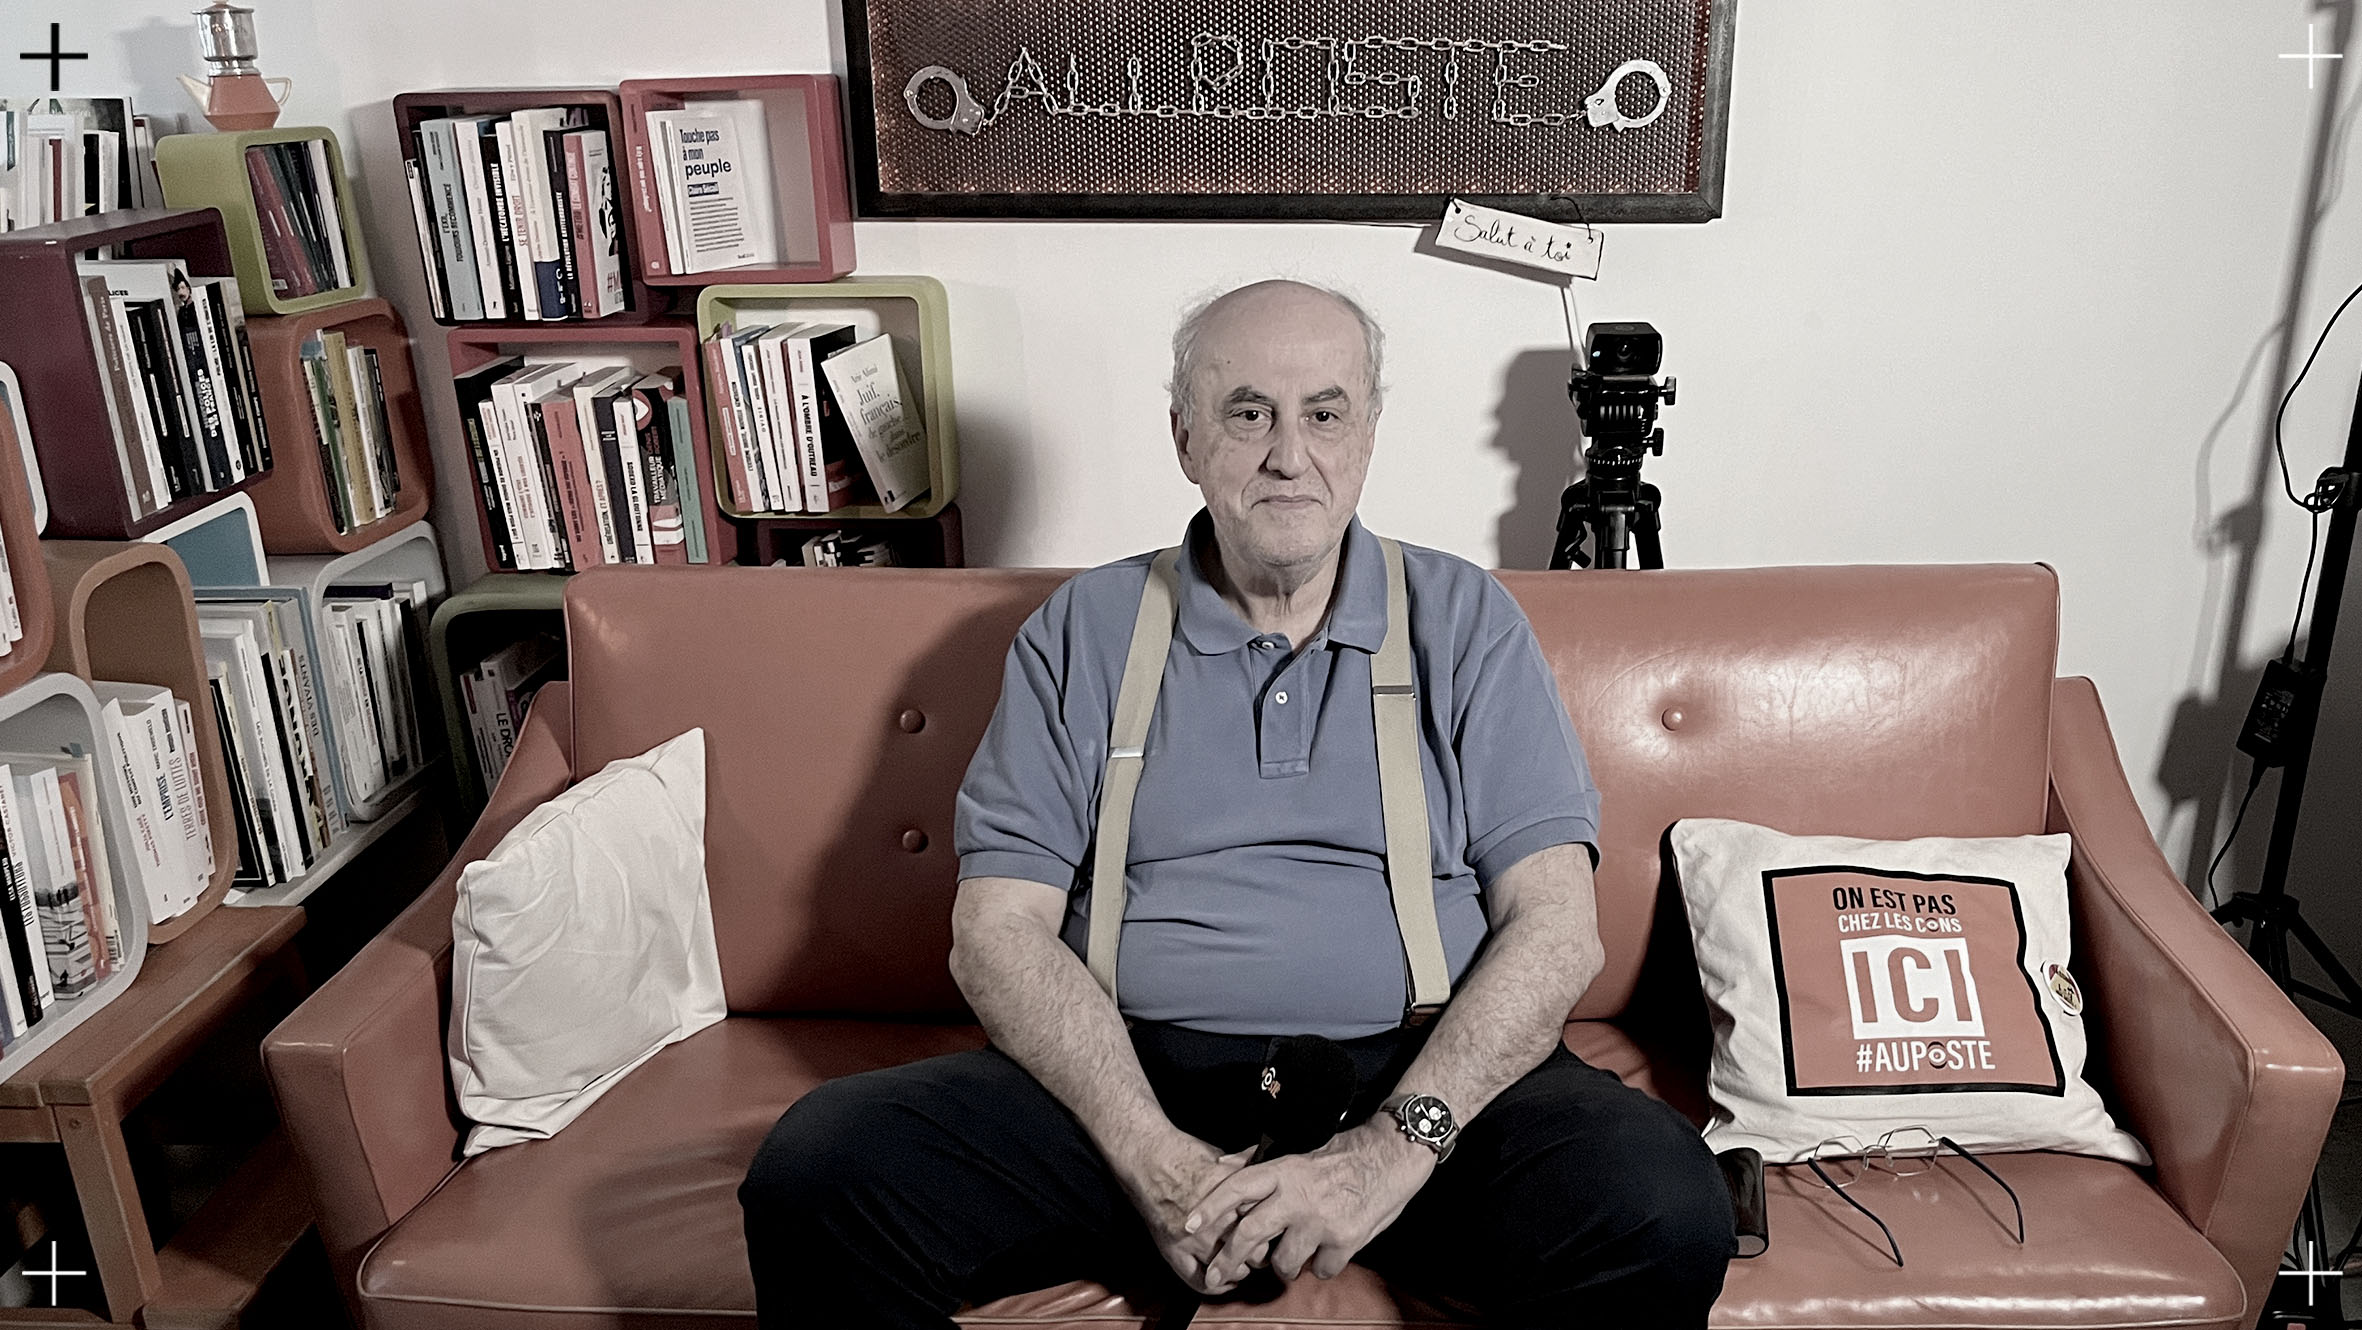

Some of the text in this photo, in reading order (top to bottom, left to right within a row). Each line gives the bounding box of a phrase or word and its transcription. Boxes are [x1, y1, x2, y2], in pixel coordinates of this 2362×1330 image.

[680, 128, 720, 145] Touche pas
[683, 145, 704, 161] à mon
[685, 159, 732, 180] peuple
[442, 182, 463, 262] TOUJOURS RECOMMENCÉ
[490, 161, 509, 242] L'HÉCATOMBE INVISIBLE
[511, 194, 527, 247] SE TENIR DROIT
[555, 191, 567, 237] ANTITERRORISTE
[561, 237, 572, 271] RÉVOLUTION
[1453, 214, 1571, 262] Salut à toi
[97, 295, 121, 372] Policiers de Paris
[194, 380, 210, 428] HISTOIRE
[195, 368, 217, 437] DES POLICES
[204, 376, 219, 425] EN FRANCE
[644, 431, 653, 455] DENIS
[649, 425, 661, 454] ROBERT
[800, 393, 818, 477] À L'OMBRE D'OUTREAU
[876, 450, 885, 462] le
[595, 483, 604, 501] APRÈS
[626, 460, 643, 532] SODEXO LA GLOUTONNE
[645, 455, 662, 503] TRAVAILLEUR
[652, 454, 669, 499] MÉDIATIQUE
[599, 501, 606, 510] ET
[298, 653, 320, 736] DES VIVANTS
[117, 730, 129, 767] POLITIQUE
[495, 711, 516, 758] LE DRO
[156, 772, 174, 820] L'EMPRISE
[167, 755, 198, 839] TERRES DE LUTTES
[198, 808, 206, 825] CEUX
[8, 829, 18, 858] VICTOR
[21, 909, 34, 927] LES
[1832, 887, 1957, 915] ON EST PAS
[1837, 911, 1963, 934] CHEZ LES CONS
[1851, 947, 1973, 1024] ICI
[1856, 1039, 1996, 1073] #AUPOSTE
